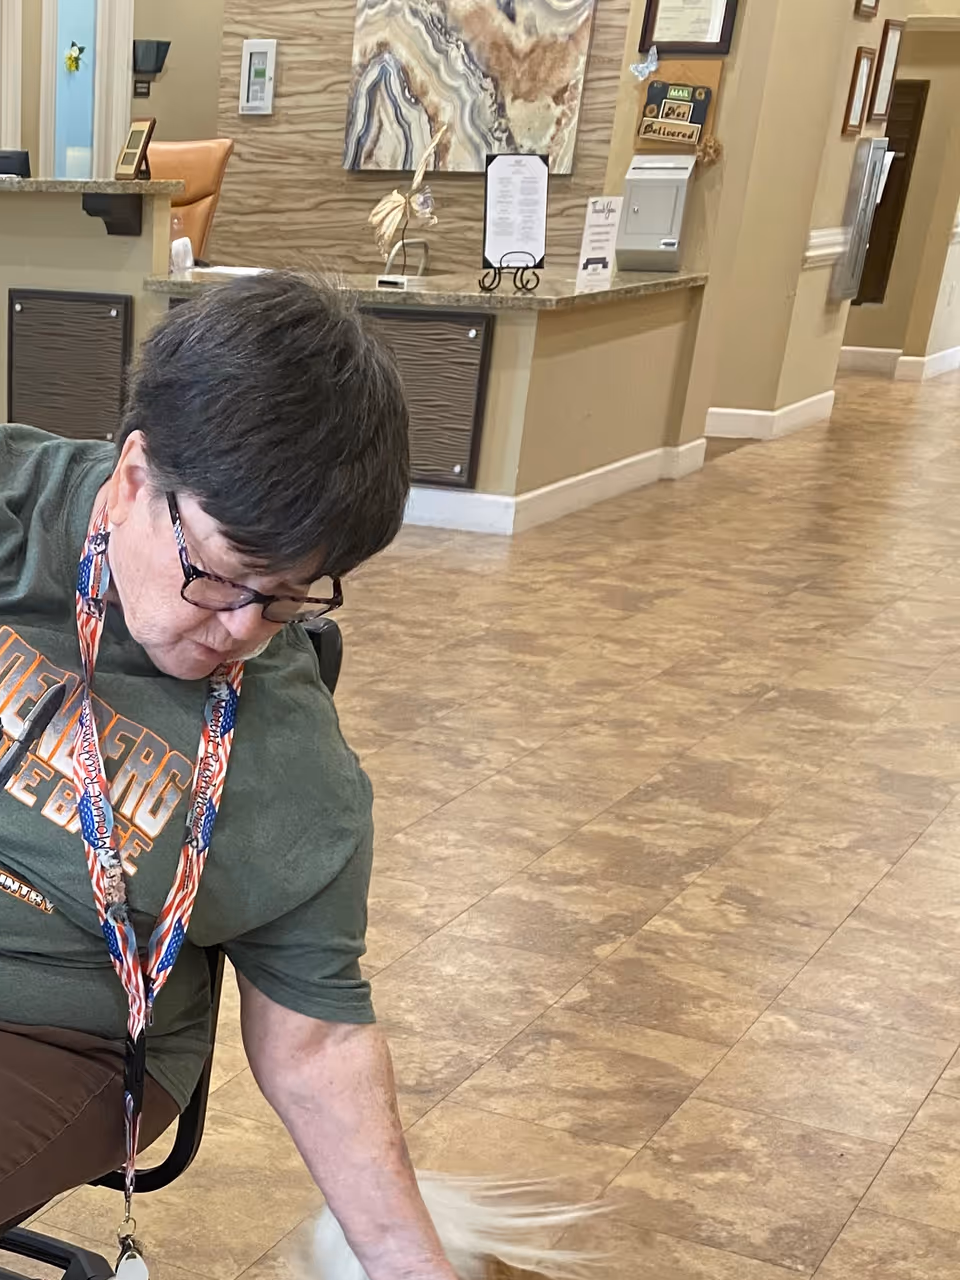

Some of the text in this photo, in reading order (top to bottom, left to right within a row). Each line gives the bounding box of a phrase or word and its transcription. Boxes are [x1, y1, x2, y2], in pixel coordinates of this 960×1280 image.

[669, 88, 689, 98] MAIL
[192, 699, 223, 836] Mount Rushmore
[41, 778, 154, 876] BE
[90, 790, 111, 851] Mount
